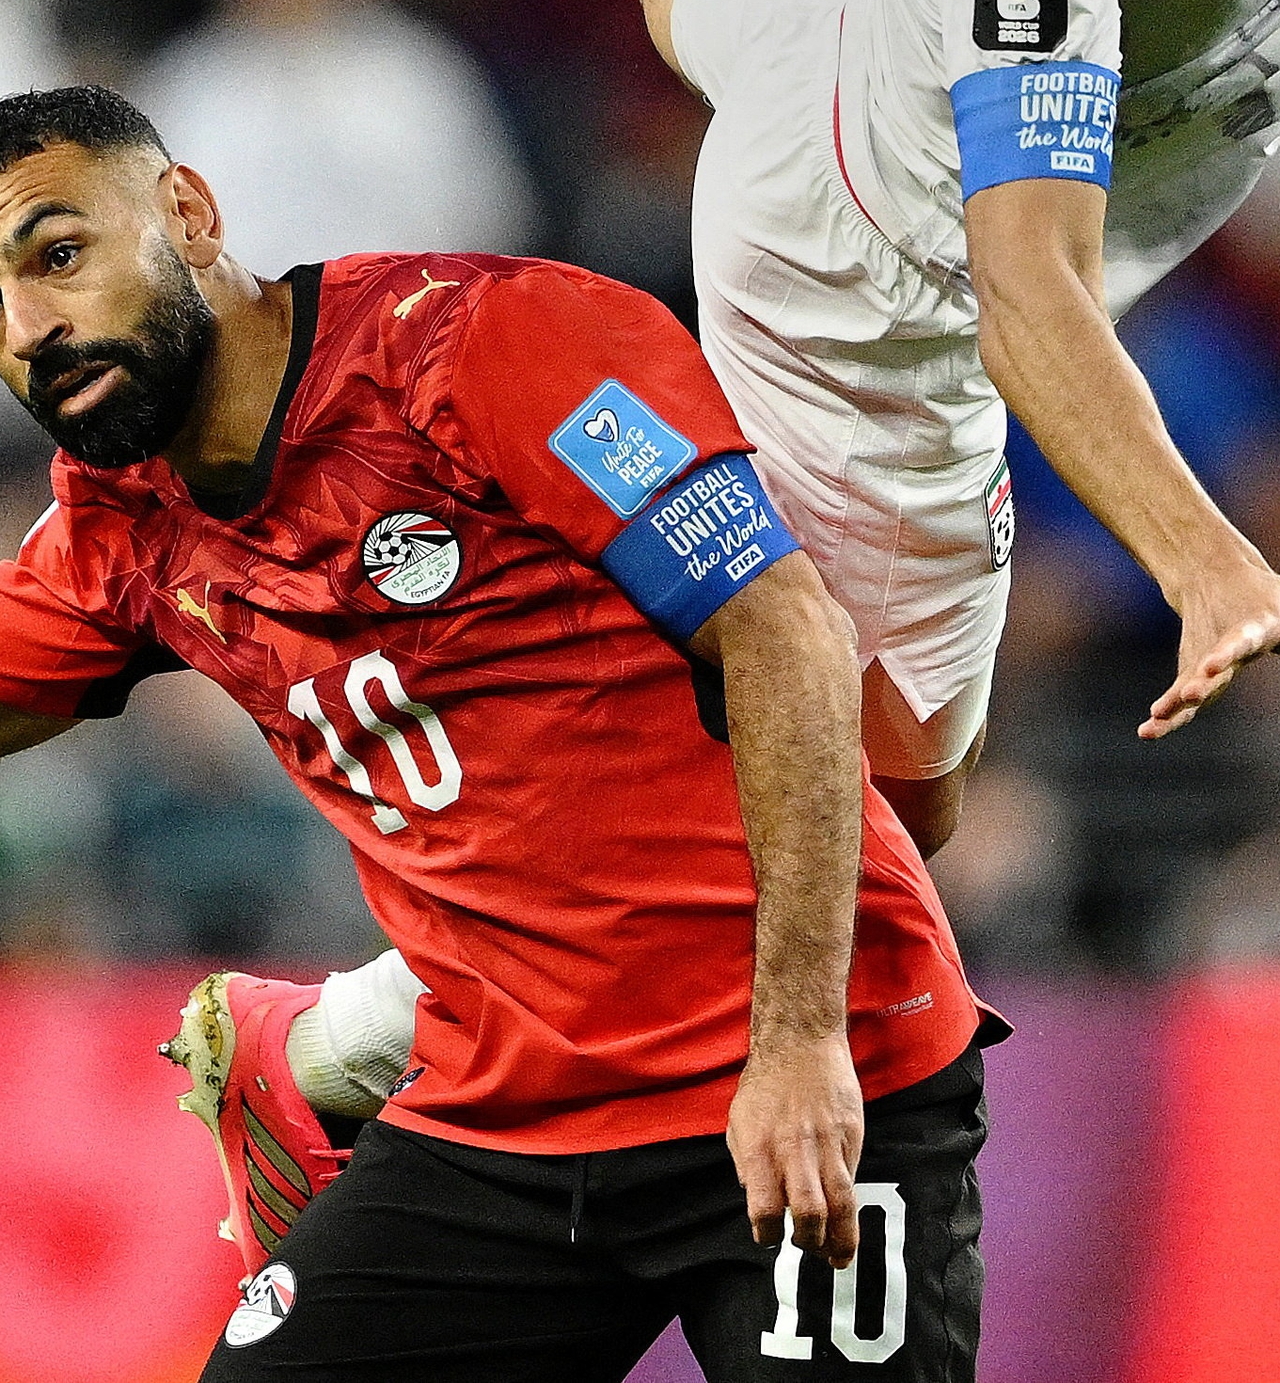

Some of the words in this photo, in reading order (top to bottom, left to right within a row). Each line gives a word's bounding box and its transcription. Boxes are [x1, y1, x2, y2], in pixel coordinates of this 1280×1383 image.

[1020, 72, 1118, 106] FOOTBALL
[1020, 94, 1117, 134] UNITES
[1015, 123, 1057, 149] the
[1055, 156, 1091, 169] FIFA
[601, 440, 632, 474] Unite
[617, 440, 663, 486] PEACE
[639, 465, 665, 488] FIFA
[650, 463, 738, 535] FOOTBALL
[665, 481, 754, 557] UNITES
[684, 553, 720, 581] the
[715, 505, 773, 556] World
[730, 550, 760, 576] FIFA
[410, 578, 444, 599] EGYPTIAN
[287, 648, 463, 836] 10
[760, 1182, 907, 1364] 10
